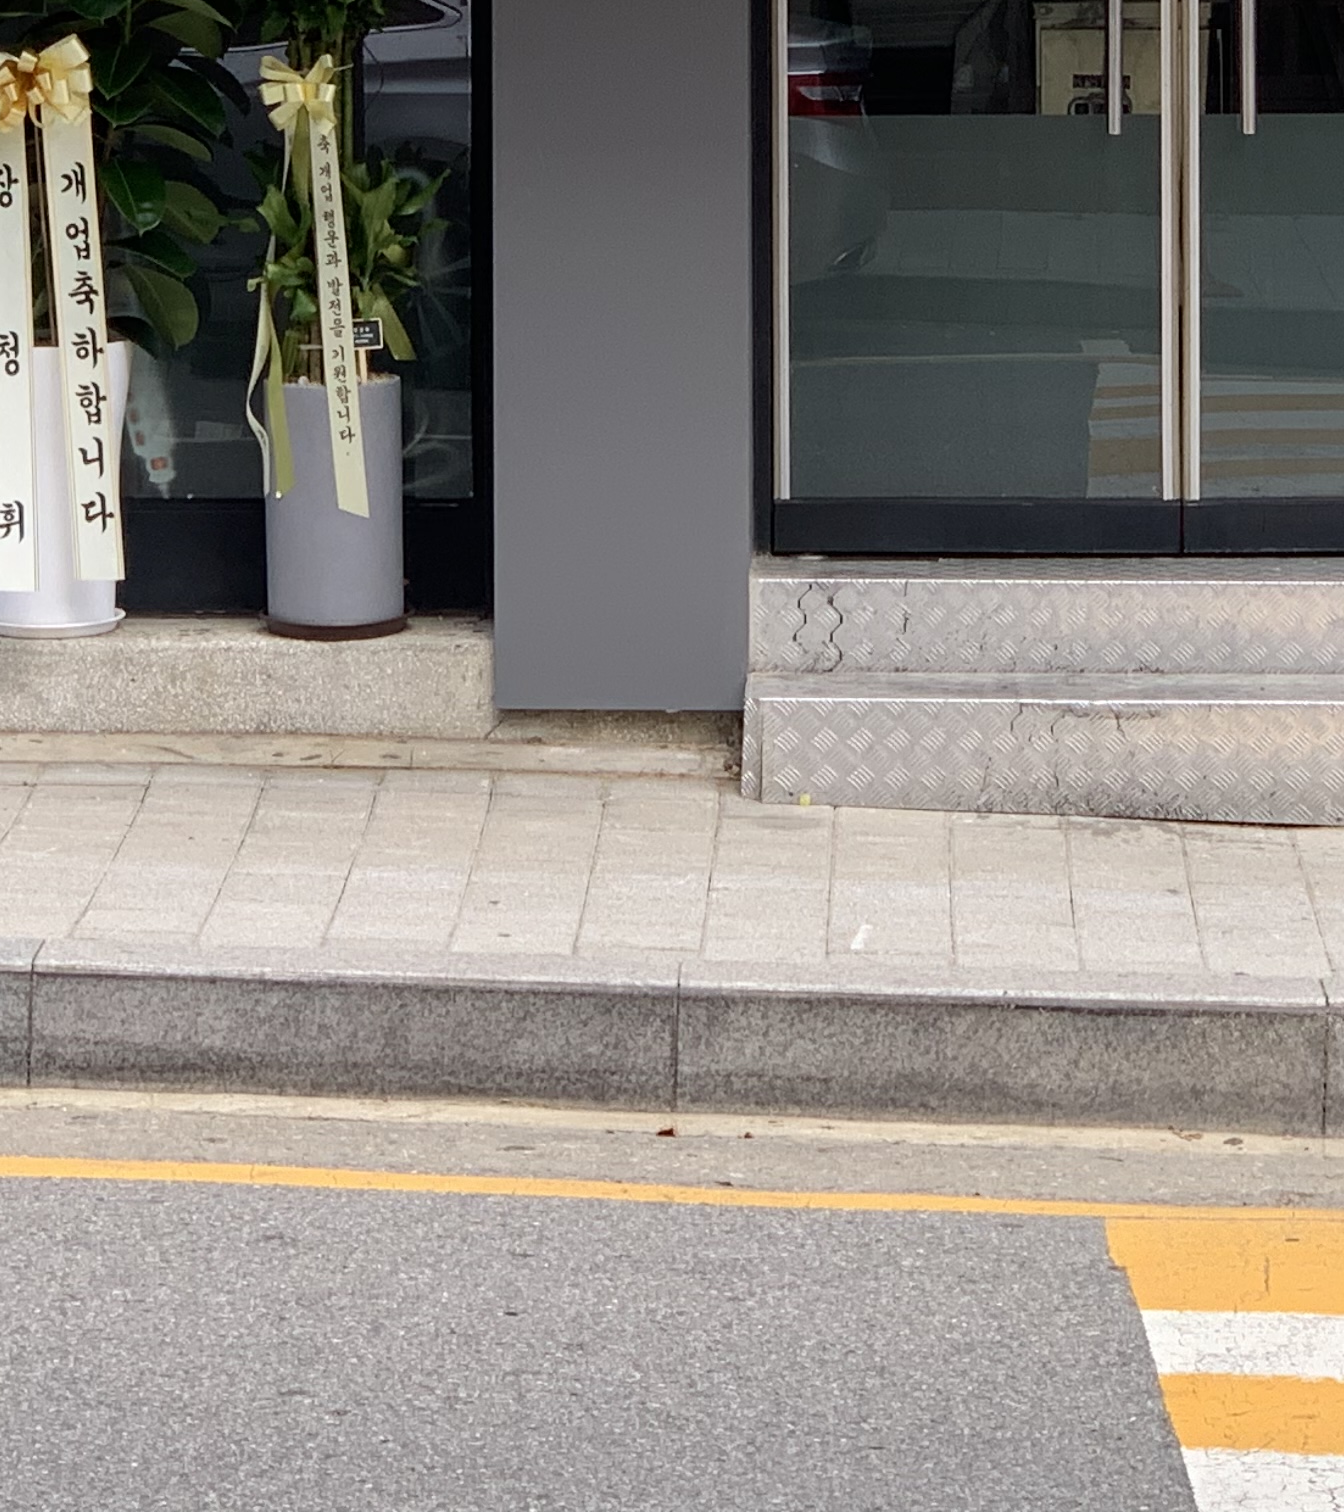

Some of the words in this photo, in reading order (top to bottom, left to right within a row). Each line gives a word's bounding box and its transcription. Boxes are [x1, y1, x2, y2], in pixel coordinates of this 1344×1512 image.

[317, 134, 330, 154] 축
[319, 161, 333, 202] 개업
[326, 276, 346, 338] 발전을
